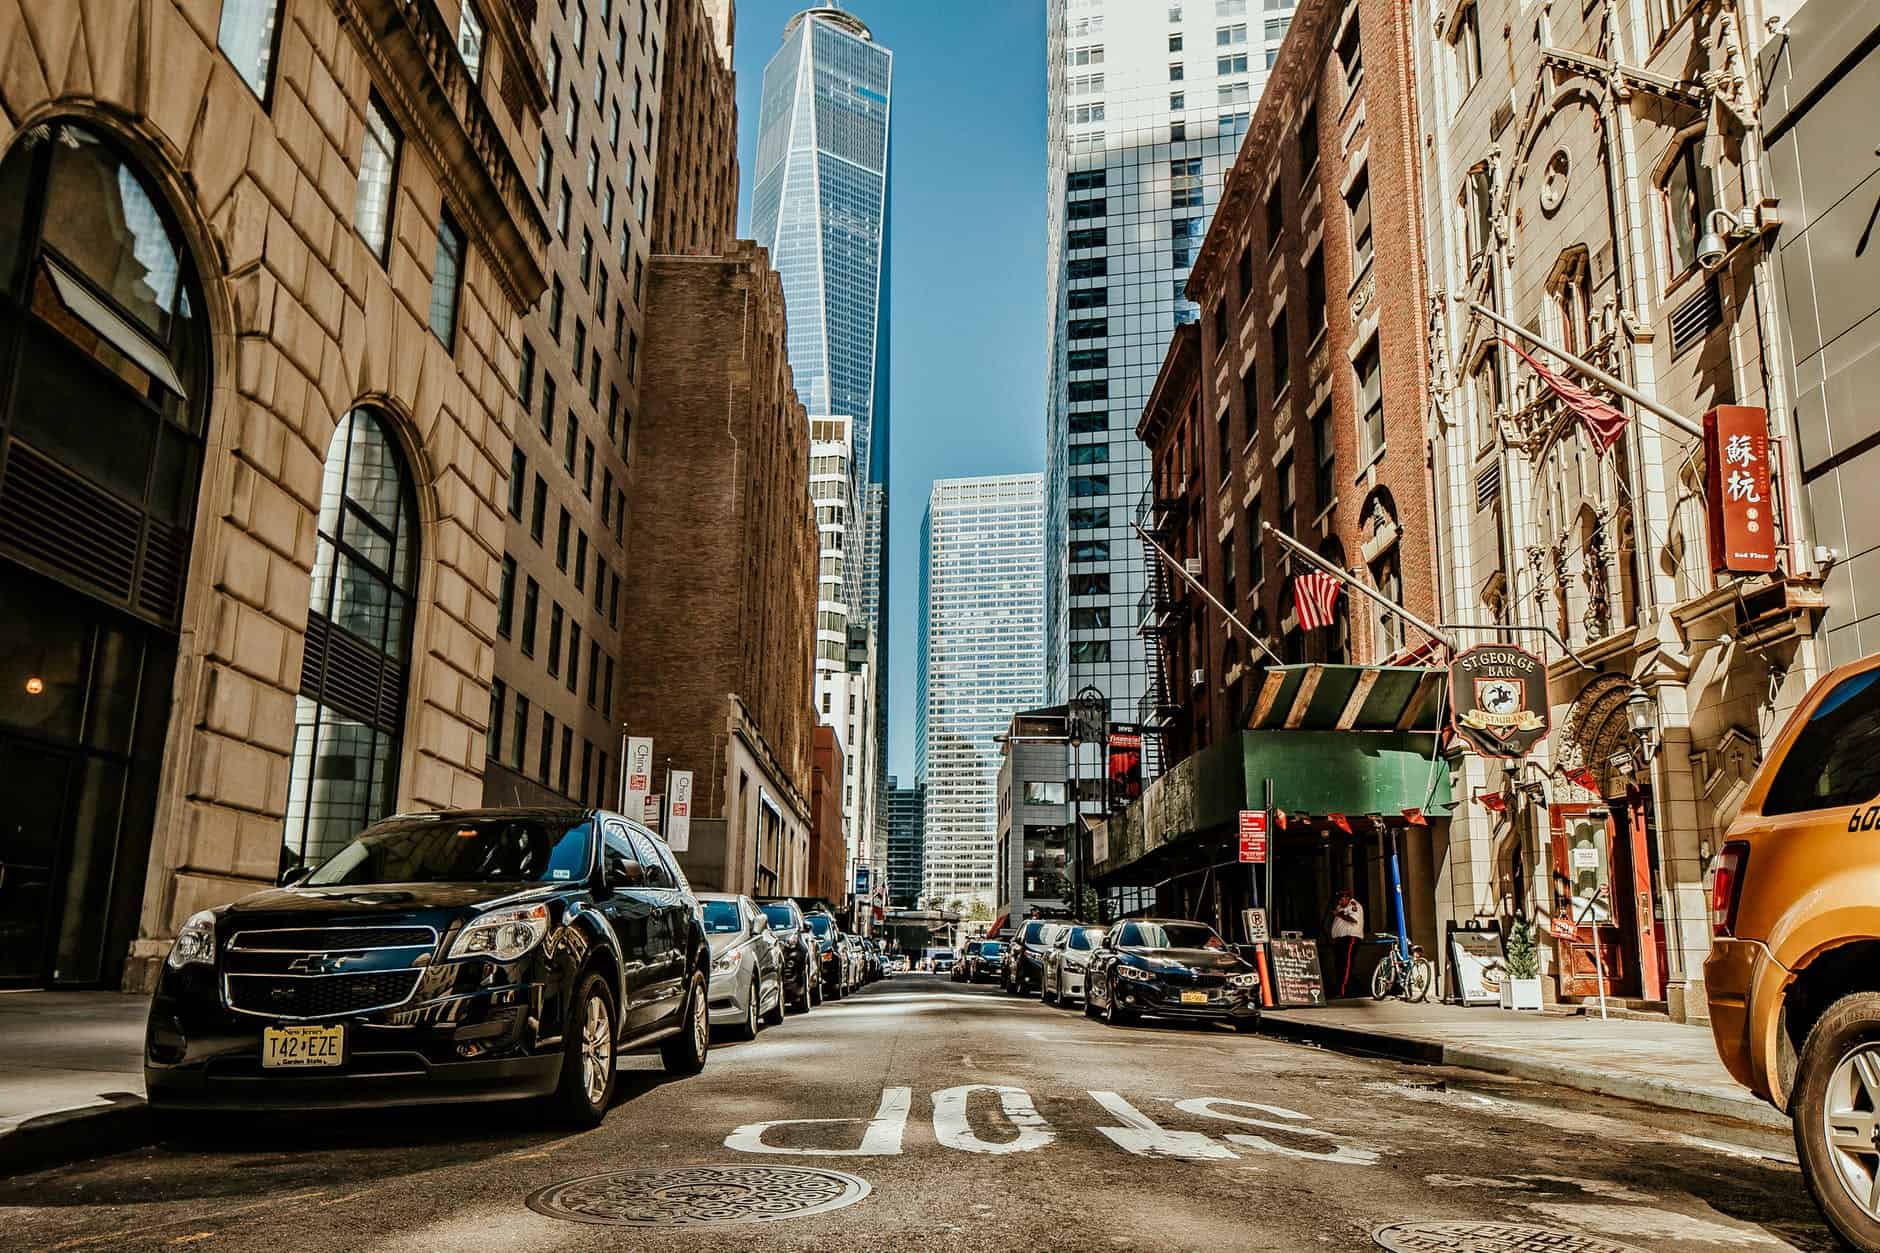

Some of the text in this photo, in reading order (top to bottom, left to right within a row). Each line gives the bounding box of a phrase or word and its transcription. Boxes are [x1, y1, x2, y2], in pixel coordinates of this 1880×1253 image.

[1725, 434, 1761, 503] 蘇杭
[1488, 665, 1513, 677] BAR
[1474, 711, 1528, 724] RESTAURANT
[636, 744, 649, 773] China
[679, 777, 689, 801] China
[722, 1084, 1382, 1166] STOP
